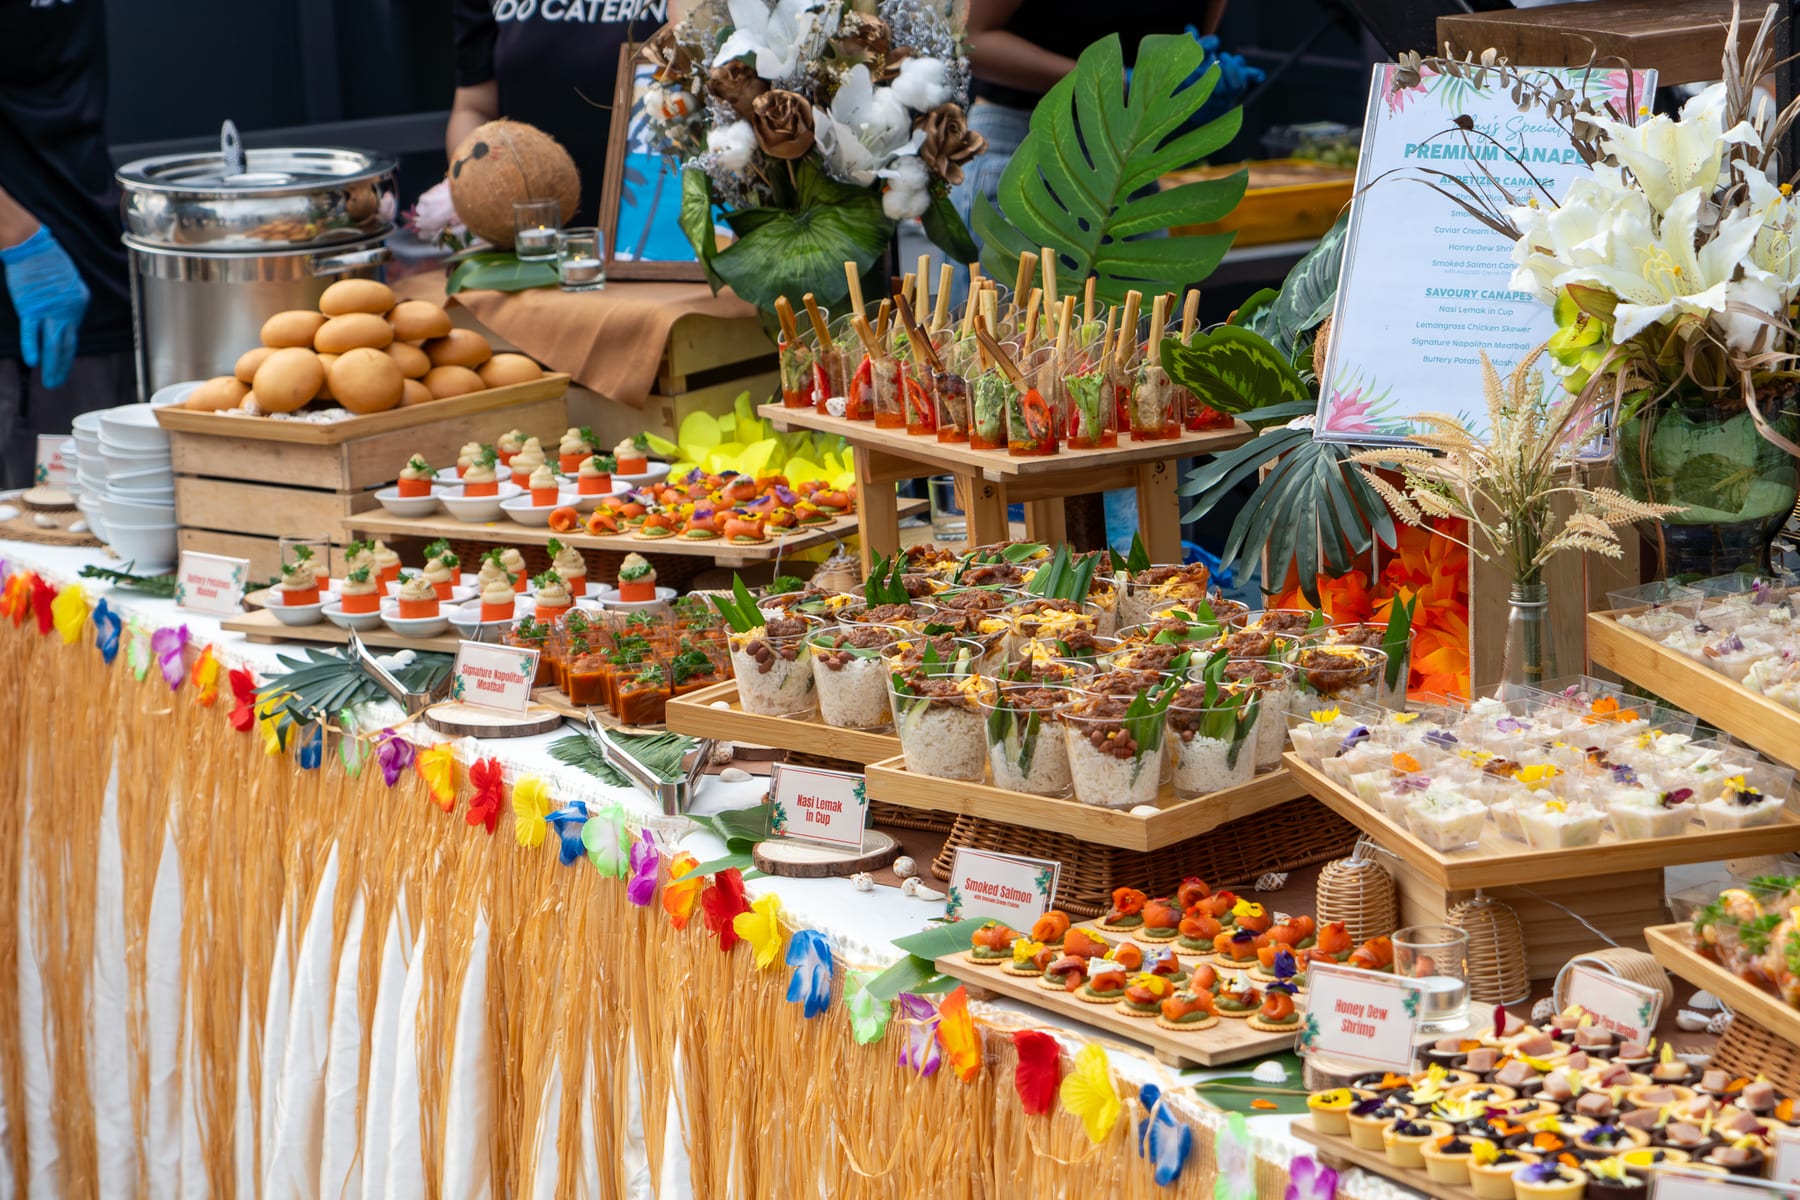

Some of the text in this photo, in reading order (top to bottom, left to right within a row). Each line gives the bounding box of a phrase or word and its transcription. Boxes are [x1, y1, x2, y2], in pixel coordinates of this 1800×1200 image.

[541, 0, 668, 23] CATERIN
[1505, 114, 1565, 143] Special
[1404, 143, 1499, 161] PREMIUM
[1434, 226, 1461, 235] Caviar
[1462, 226, 1490, 236] Cream
[1448, 243, 1475, 252] Honey
[1476, 244, 1494, 252] Dew
[1432, 259, 1465, 268] Smoked
[1466, 261, 1497, 269] Salmon
[1425, 287, 1533, 301] SAVOURY CANAPES
[1439, 305, 1457, 313] Nasi
[1458, 306, 1486, 315] Lemak
[1497, 308, 1514, 317] Cup
[1415, 321, 1531, 333] Lemongrass Chicken Skewer
[1411, 338, 1530, 350] Signature Napolitan Meatball
[461, 664, 525, 685] Signature Napolitan
[476, 679, 506, 693] Meatball
[797, 794, 843, 813] Nasi Lemak
[805, 809, 831, 826] in Cup
[965, 877, 999, 896] Smoked
[1000, 885, 1032, 904] Salmon
[1335, 999, 1388, 1021] Honey Dew
[1341, 1018, 1376, 1039] Shrimp
